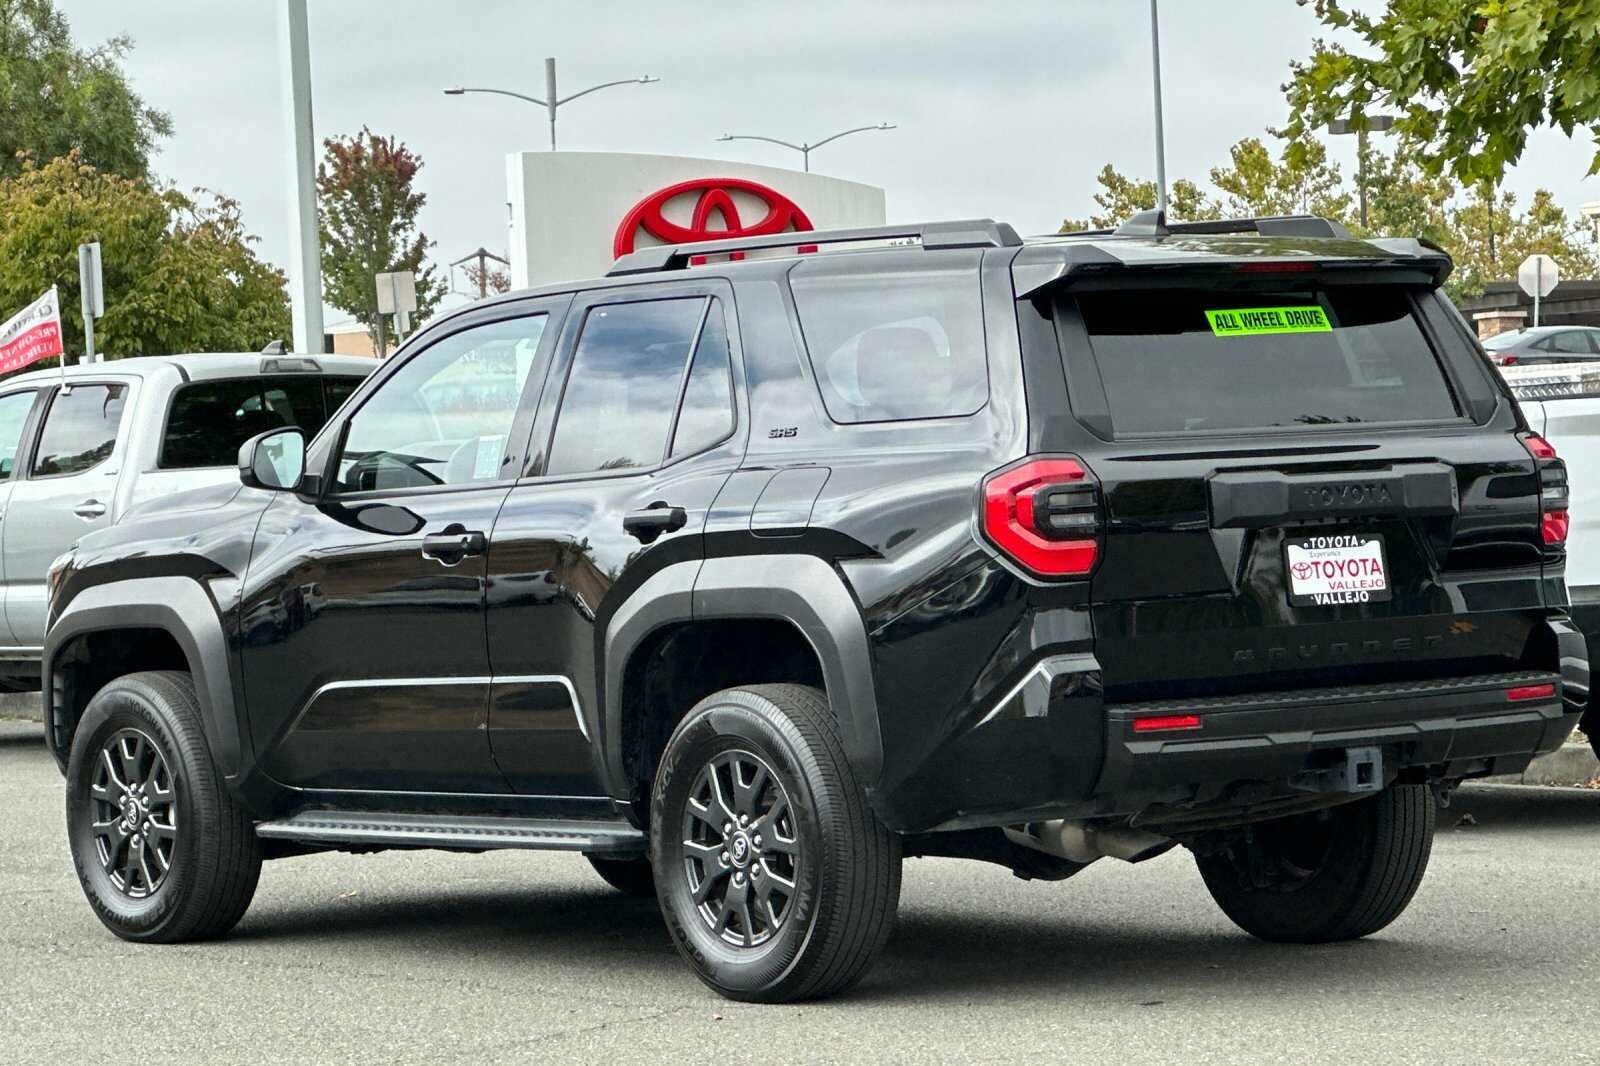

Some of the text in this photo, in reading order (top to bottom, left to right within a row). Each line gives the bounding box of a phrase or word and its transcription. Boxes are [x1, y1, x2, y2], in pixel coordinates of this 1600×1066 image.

[1214, 309, 1324, 329] ALL WHEEL DRIVE
[1303, 483, 1393, 508] TOYOTA
[1309, 535, 1359, 549] TOYOTA
[1311, 558, 1382, 579] TOYOTA
[1328, 579, 1384, 590] VALLEJO
[1314, 591, 1369, 605] VALLEJO
